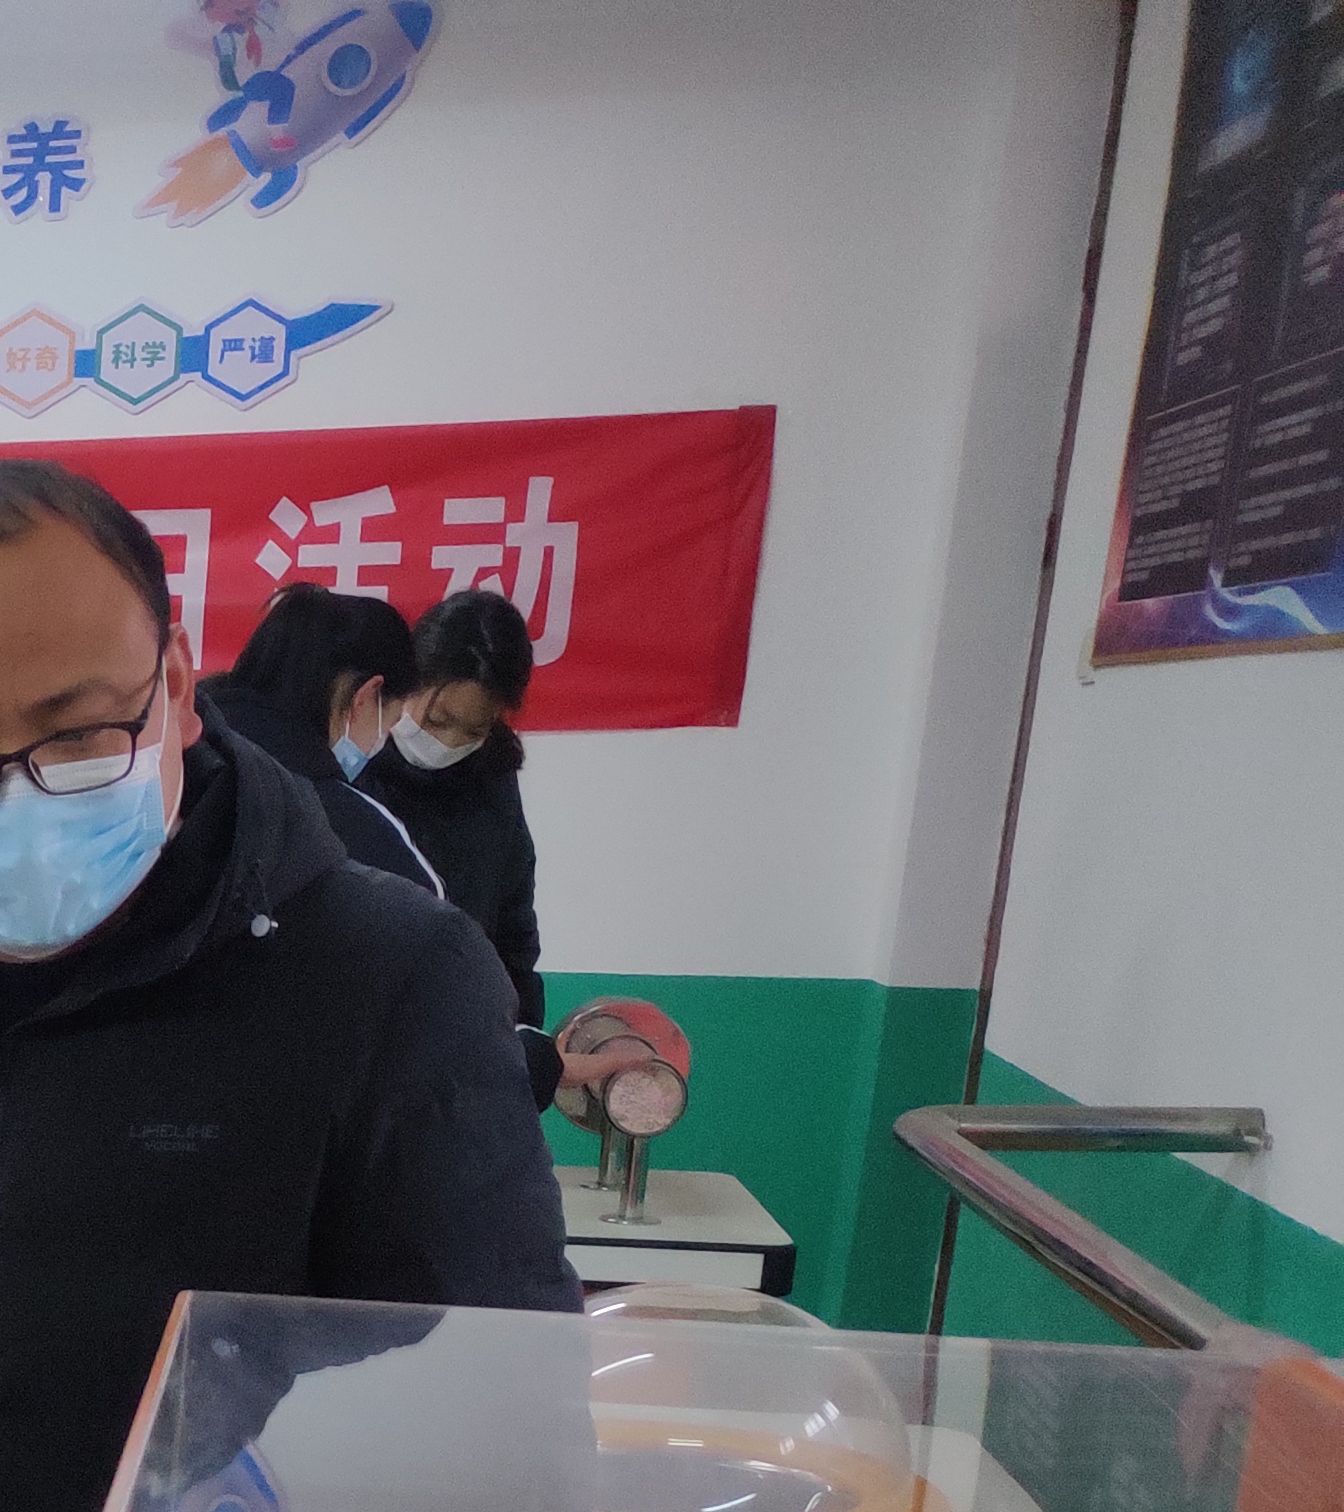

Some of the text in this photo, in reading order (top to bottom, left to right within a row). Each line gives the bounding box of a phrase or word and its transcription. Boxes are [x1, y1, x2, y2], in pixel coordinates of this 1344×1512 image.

[5, 344, 59, 374] 好奇
[110, 340, 167, 370] 科学
[218, 335, 275, 366] 严谨
